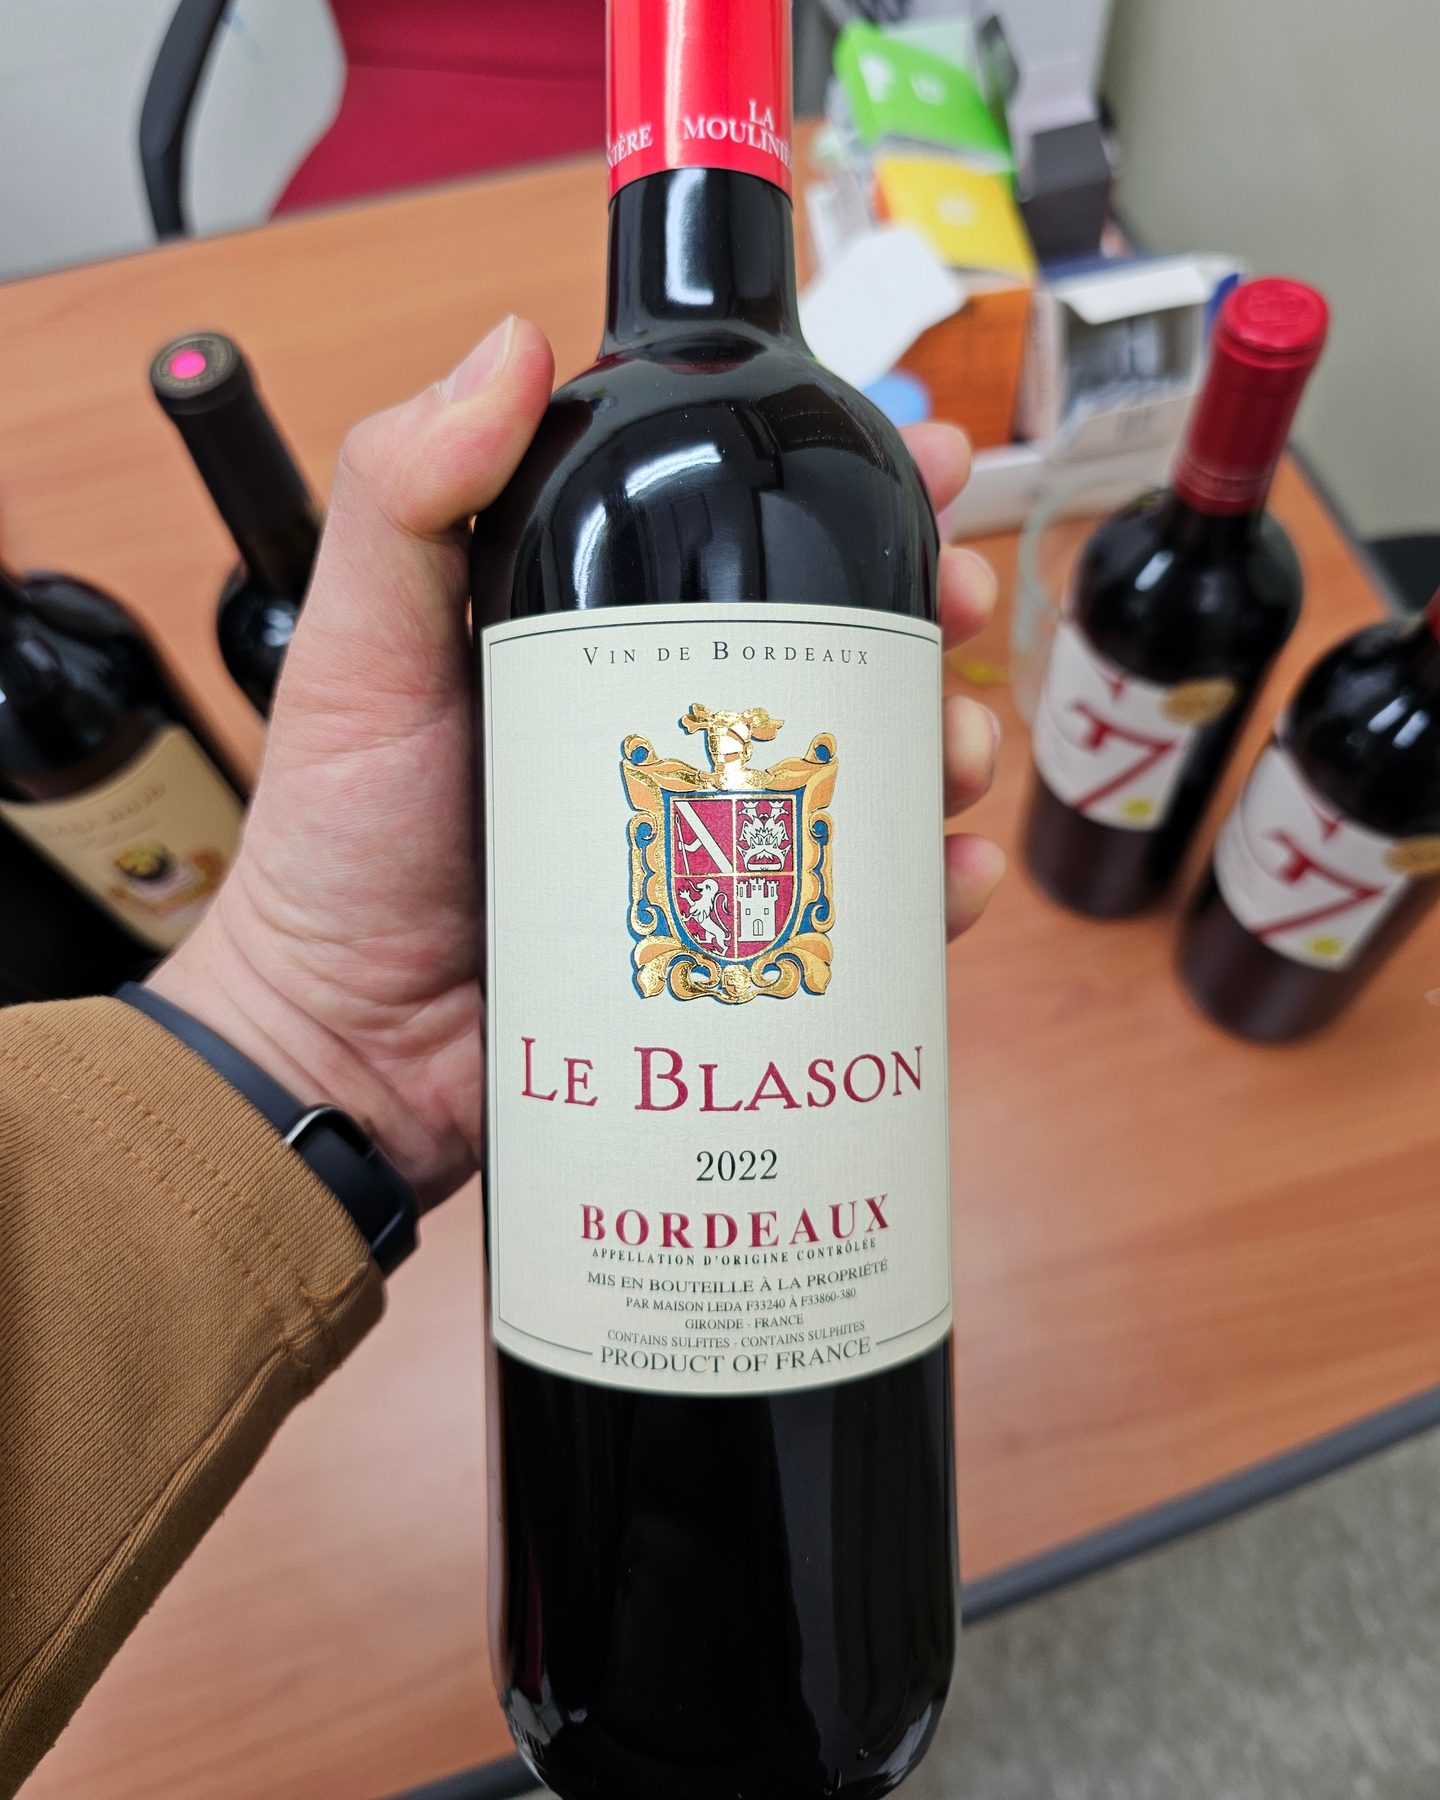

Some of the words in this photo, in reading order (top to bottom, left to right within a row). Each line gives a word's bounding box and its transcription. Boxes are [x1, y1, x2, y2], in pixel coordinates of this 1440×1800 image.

[748, 98, 774, 132] LA
[657, 647, 690, 661] DE
[696, 1149, 778, 1182] 2022
[580, 1193, 889, 1249] BORDEAUX
[592, 1248, 695, 1265] APPELLATION
[703, 1252, 789, 1266] D'ORIGINE
[796, 1237, 876, 1261] CONTRÔLÉE
[587, 1270, 616, 1287] MIS
[621, 1276, 644, 1290] EN
[650, 1278, 754, 1293] BOUTEILLE
[760, 1276, 772, 1292] À
[778, 1277, 801, 1290] LA
[807, 1256, 888, 1287] PROPRIÉTÉ
[626, 1296, 649, 1308] PAR
[653, 1300, 704, 1312] MAISON
[707, 1301, 742, 1312] LEDA
[746, 1298, 786, 1311] F33240
[789, 1294, 798, 1308] À
[607, 1329, 668, 1347] CONTAINS
[671, 1336, 730, 1349] SULFITES
[741, 1331, 805, 1348] CONTAINS
[808, 1320, 865, 1341] SULPHITES
[685, 1318, 743, 1330] GIRONDE
[754, 1313, 804, 1328] FRANCE
[601, 1345, 725, 1373] PRODUCT
[733, 1354, 768, 1373] OF
[776, 1335, 871, 1369] FRANCE
